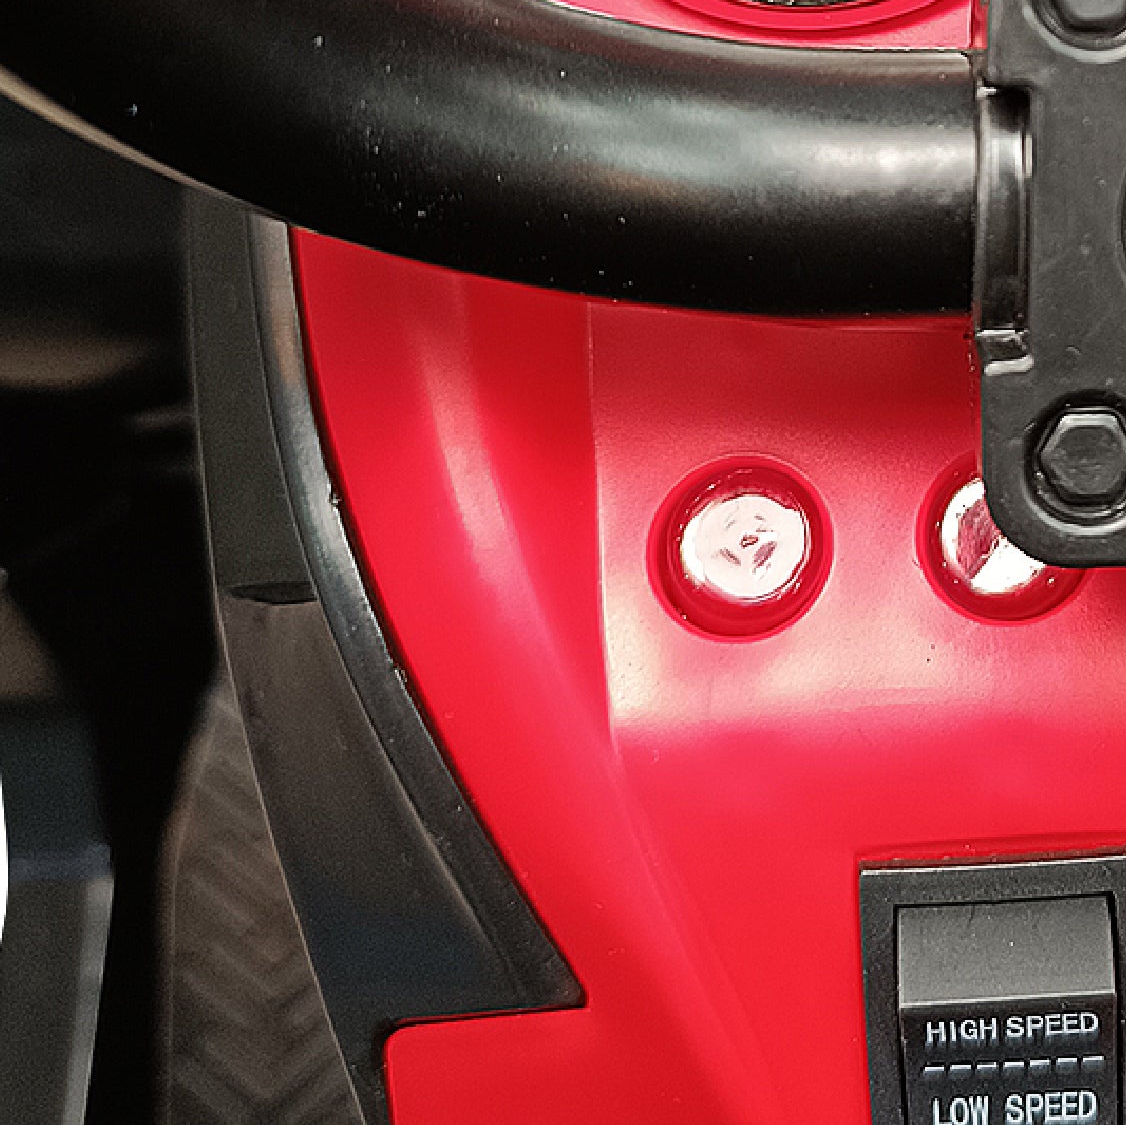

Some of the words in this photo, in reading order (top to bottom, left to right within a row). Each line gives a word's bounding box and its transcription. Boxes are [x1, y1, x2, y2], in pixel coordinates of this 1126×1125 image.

[926, 1017, 997, 1043] HIGH
[1006, 1012, 1099, 1039] SPEED
[932, 1095, 990, 1125] LOW
[1005, 1090, 1098, 1125] SPEED
